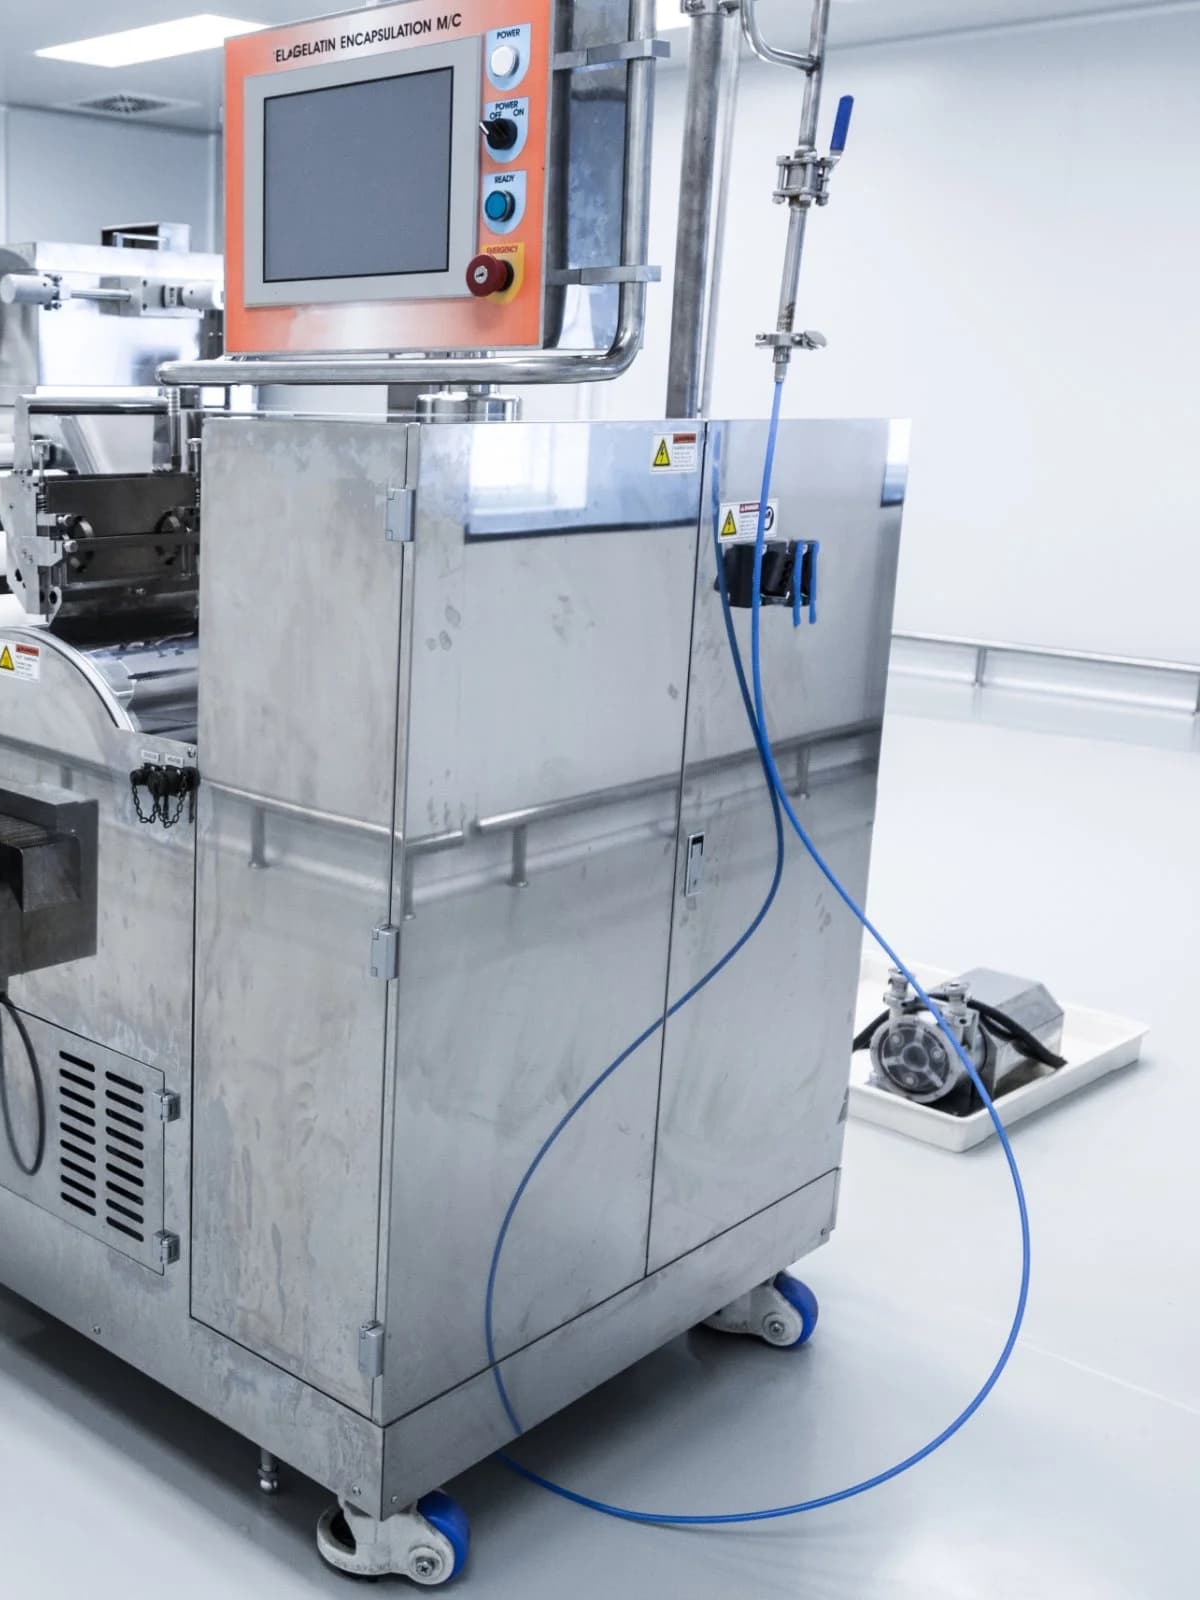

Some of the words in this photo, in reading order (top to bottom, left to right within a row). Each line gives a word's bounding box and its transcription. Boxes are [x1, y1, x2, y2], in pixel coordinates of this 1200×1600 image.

[340, 19, 431, 48] ENCAPSULATION
[436, 13, 462, 31] M/C
[496, 28, 520, 39] POWER
[495, 100, 519, 111] POWER
[489, 110, 502, 120] OFF
[513, 107, 525, 117] ON
[494, 174, 515, 184] READY
